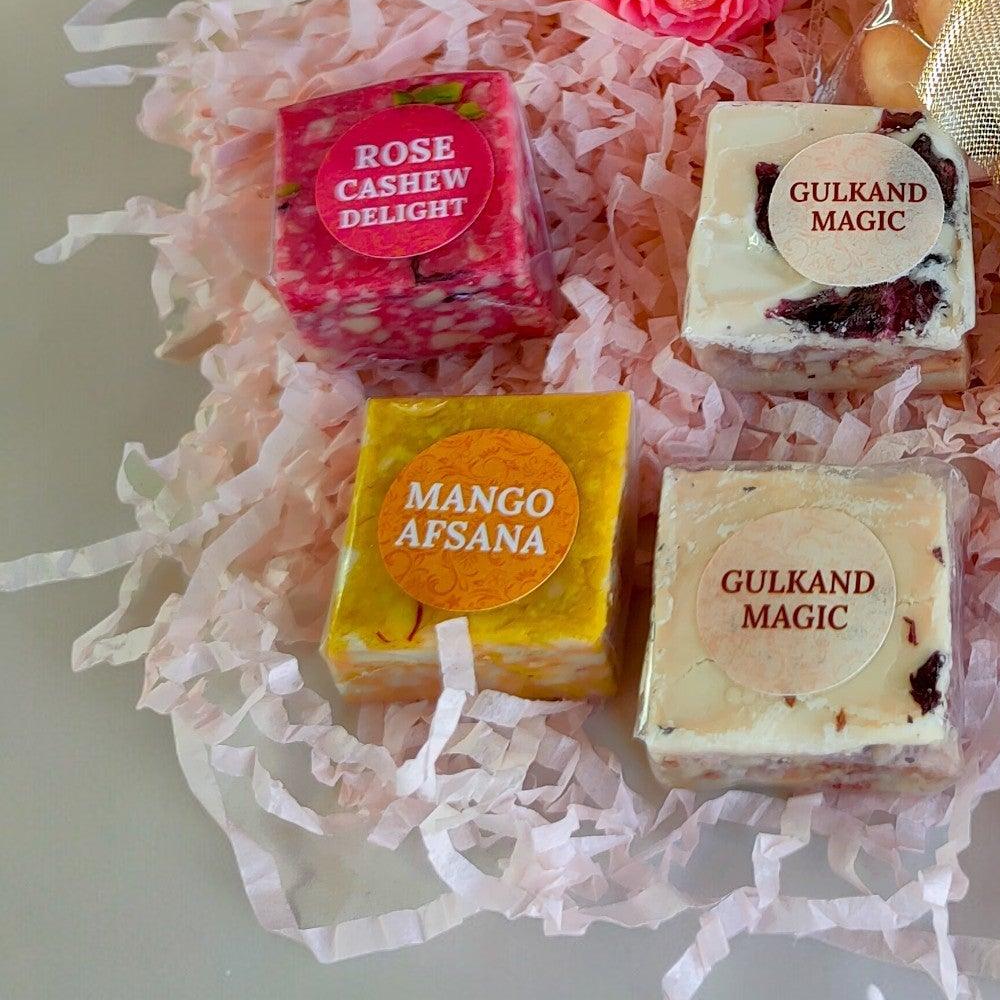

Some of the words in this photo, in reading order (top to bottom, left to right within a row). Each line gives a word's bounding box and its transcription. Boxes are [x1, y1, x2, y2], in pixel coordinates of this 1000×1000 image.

[353, 135, 456, 171] ROSE
[334, 166, 472, 202] CASHEW
[789, 181, 928, 203] GULKAND
[337, 197, 468, 230] DELIGHT
[811, 210, 906, 232] MAGIC
[404, 481, 555, 518] MANGO
[395, 517, 547, 556] AFSANA
[721, 569, 875, 594] GULKAND
[741, 603, 849, 630] MAGIC
